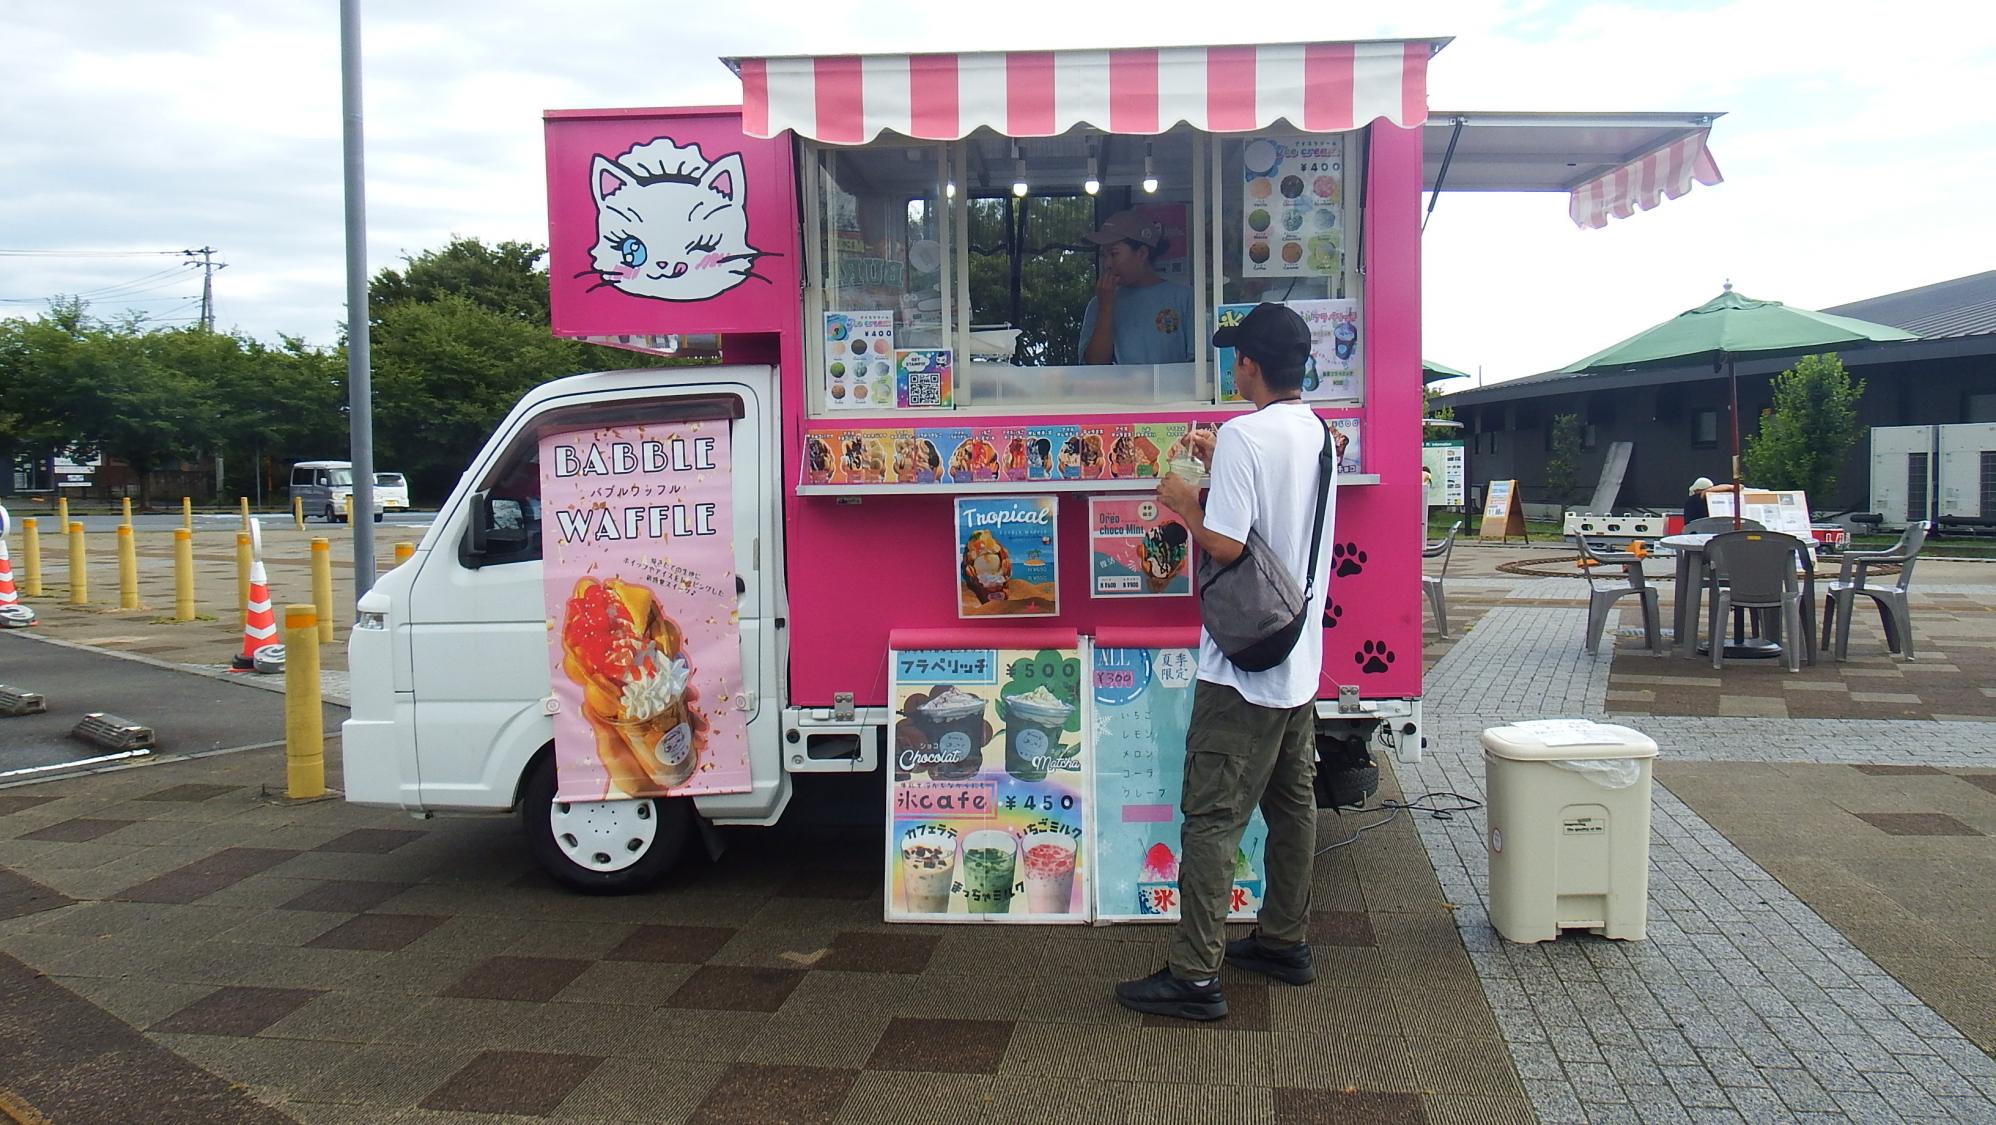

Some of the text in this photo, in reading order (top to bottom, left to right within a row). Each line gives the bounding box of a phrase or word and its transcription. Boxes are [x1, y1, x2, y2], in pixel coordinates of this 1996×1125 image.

[1300, 162, 1341, 172] ¥400
[554, 437, 717, 478] BABBLE
[590, 484, 682, 499] バブルワッフル
[556, 503, 717, 543] WAFFLE
[963, 504, 1050, 528] Tropical
[1099, 512, 1120, 524] Oreo
[1099, 523, 1145, 535] choco Mint
[1097, 648, 1131, 667] ALL
[1161, 652, 1189, 668] 夏季
[900, 657, 989, 675] フラペリッチ
[1005, 663, 1076, 679] ¥500
[1161, 668, 1189, 682] 限定
[1121, 710, 1153, 721] いちご
[1122, 730, 1154, 741] レモン
[898, 749, 962, 771] Chocolat
[1122, 749, 1154, 760] メロン
[1031, 756, 1081, 773] Matcha
[1123, 768, 1154, 779] コーラ
[1005, 795, 1075, 811] ¥450
[905, 823, 959, 840] カフェラテ
[1016, 817, 1083, 840] いちごミルク
[950, 880, 1025, 903] まっちゃミルク
[1153, 888, 1177, 913] 氷
